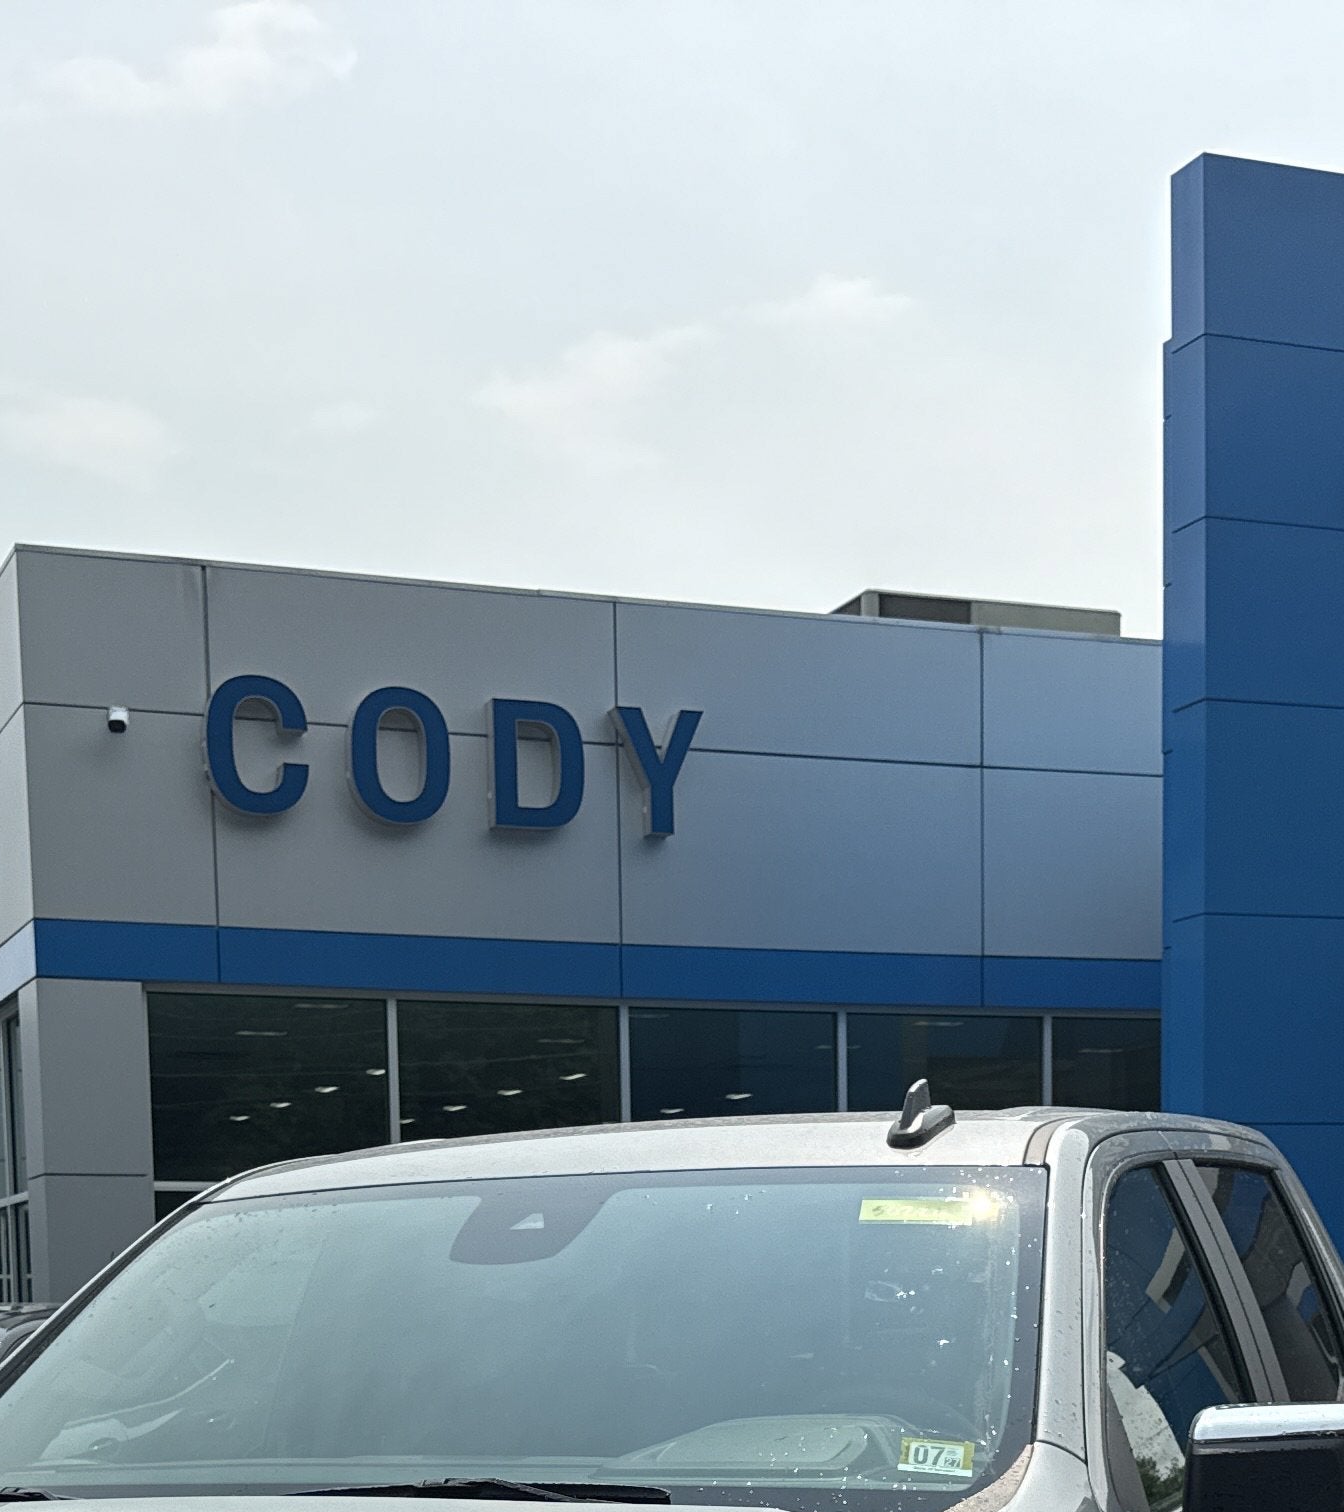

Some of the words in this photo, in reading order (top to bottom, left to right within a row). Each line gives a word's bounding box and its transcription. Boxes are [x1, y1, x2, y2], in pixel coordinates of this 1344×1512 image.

[203, 673, 704, 837] CODY
[913, 1444, 946, 1466] 07
[944, 1456, 961, 1468] 27
